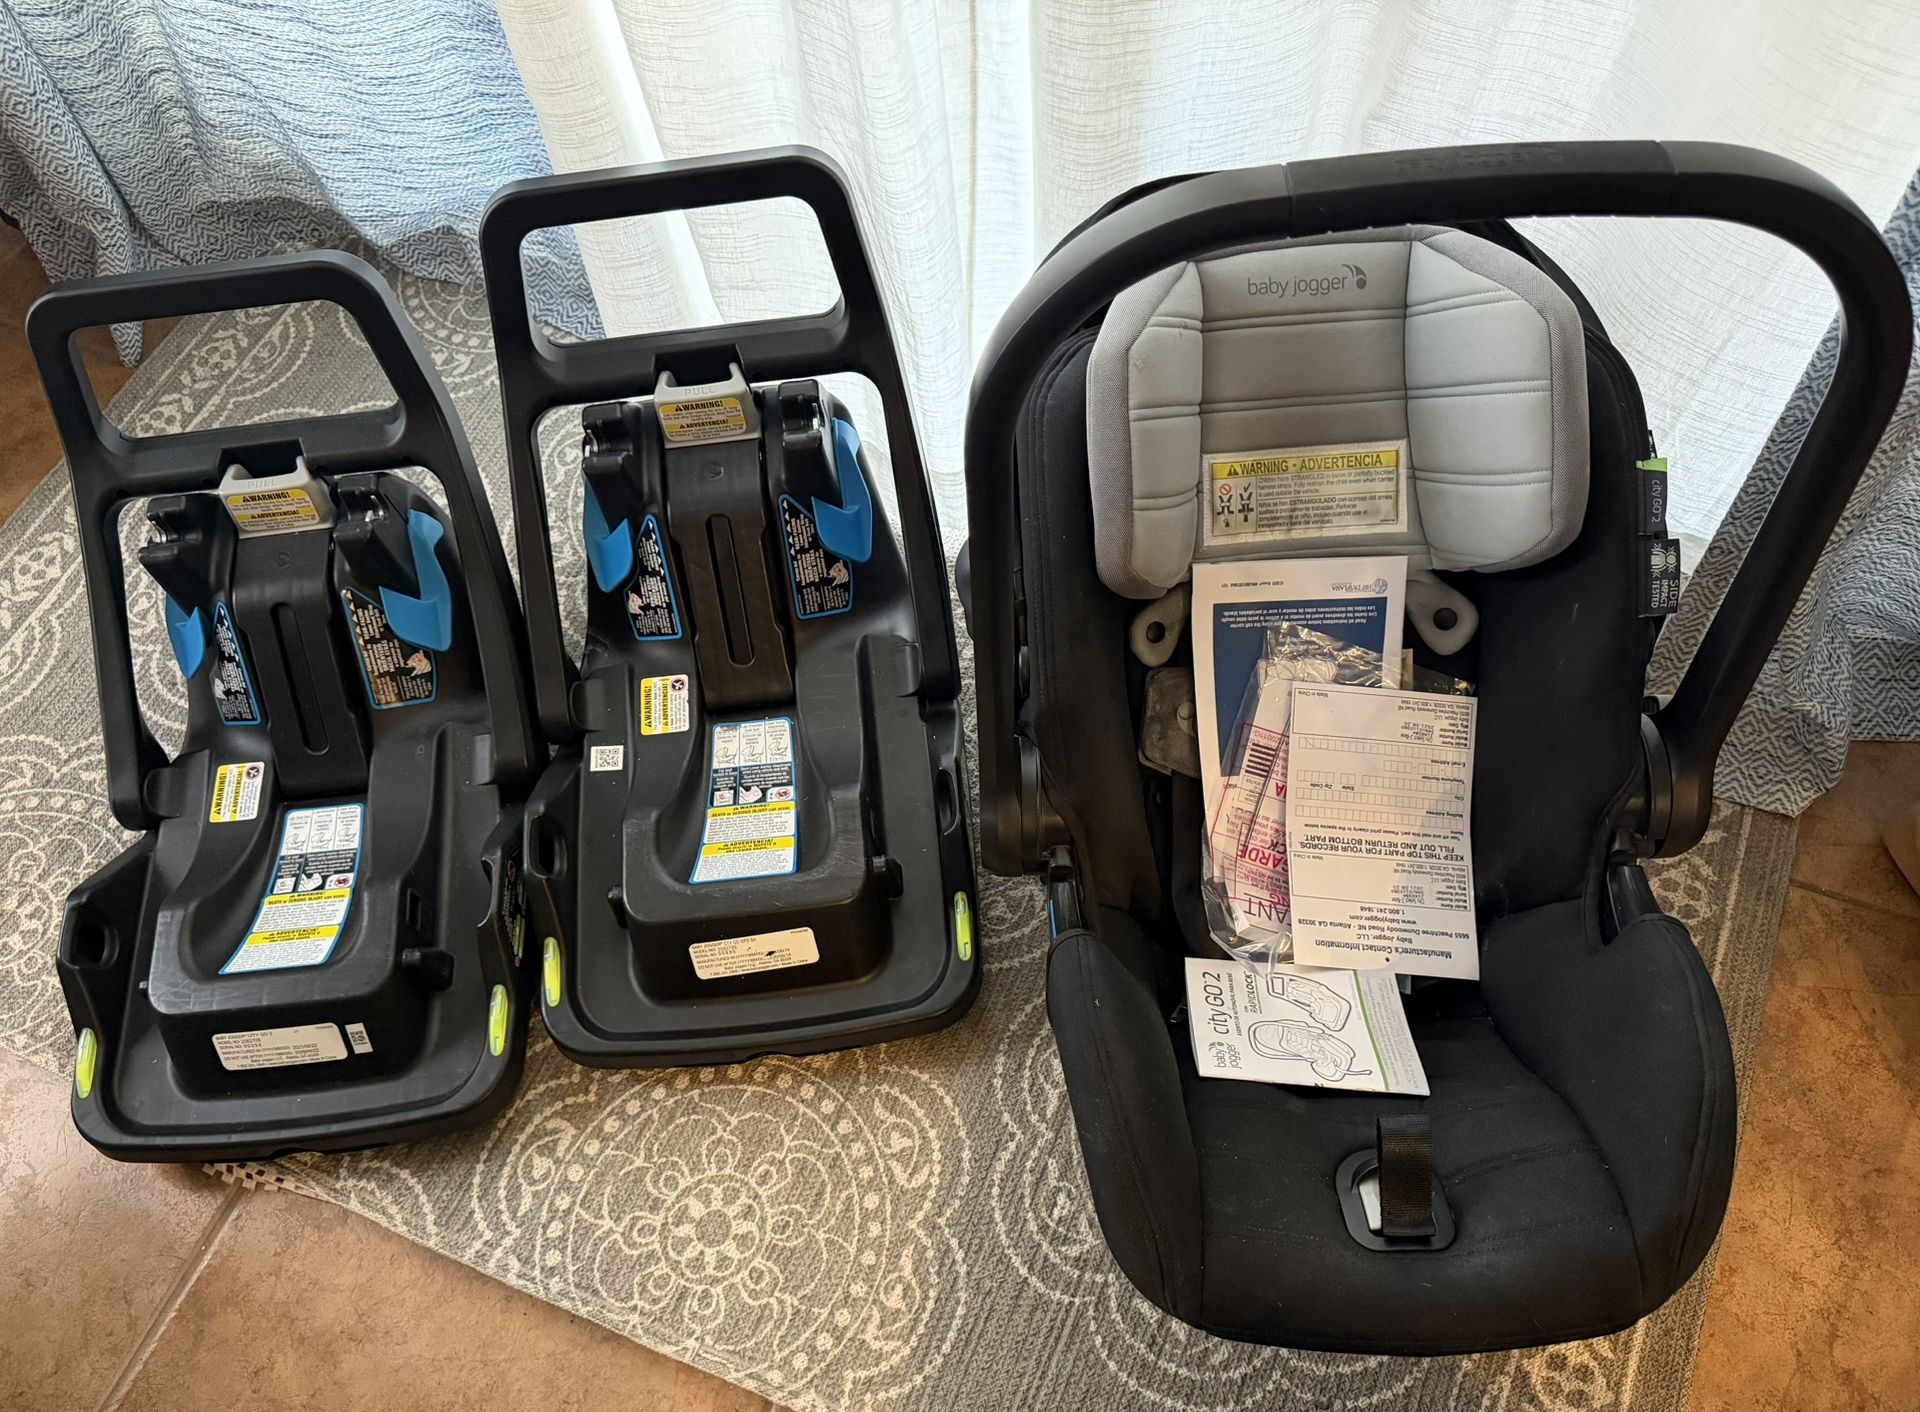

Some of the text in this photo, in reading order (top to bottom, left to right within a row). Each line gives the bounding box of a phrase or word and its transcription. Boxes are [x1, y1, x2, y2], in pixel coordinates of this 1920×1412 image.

[1247, 271, 1348, 300] baby jogger
[684, 385, 715, 396] PULL
[681, 399, 723, 411] WARNING!
[686, 418, 728, 428] ADVERTENCIA!
[1239, 452, 1382, 475] WARNING ADVERTENCIA
[249, 490, 290, 503] WARNING!
[256, 508, 299, 519] ADVERTENCIA!
[1651, 580, 1659, 607] TESTED
[1659, 579, 1667, 607] IMPACT
[1669, 579, 1678, 606] SIDE
[643, 685, 651, 720] WARNING!
[214, 772, 226, 808] WARNING!
[232, 770, 242, 807] ADVERTENCIA!
[1297, 841, 1339, 850] RECORDS.
[1327, 836, 1362, 845] BOTTOM
[1364, 839, 1398, 847] RETURN
[1340, 845, 1363, 853] YOUR
[1383, 848, 1404, 856] PART
[1406, 850, 1421, 858] TOP
[1443, 853, 1464, 861] KEEP
[1297, 917, 1316, 925] 30328
[1348, 914, 1416, 925] www.babyjogger.com
[1386, 925, 1419, 934] Dunwoody
[1421, 929, 1452, 937] Peachtree
[1370, 933, 1394, 941] Jogger,
[1396, 935, 1412, 943] Baby
[1314, 939, 1451, 958] Manufacturer's Contact Information
[1207, 1008, 1231, 1034] city
[1234, 1021, 1242, 1036] ASIENTO
[1214, 1048, 1226, 1067] baby
[1224, 1041, 1242, 1069] jogger
